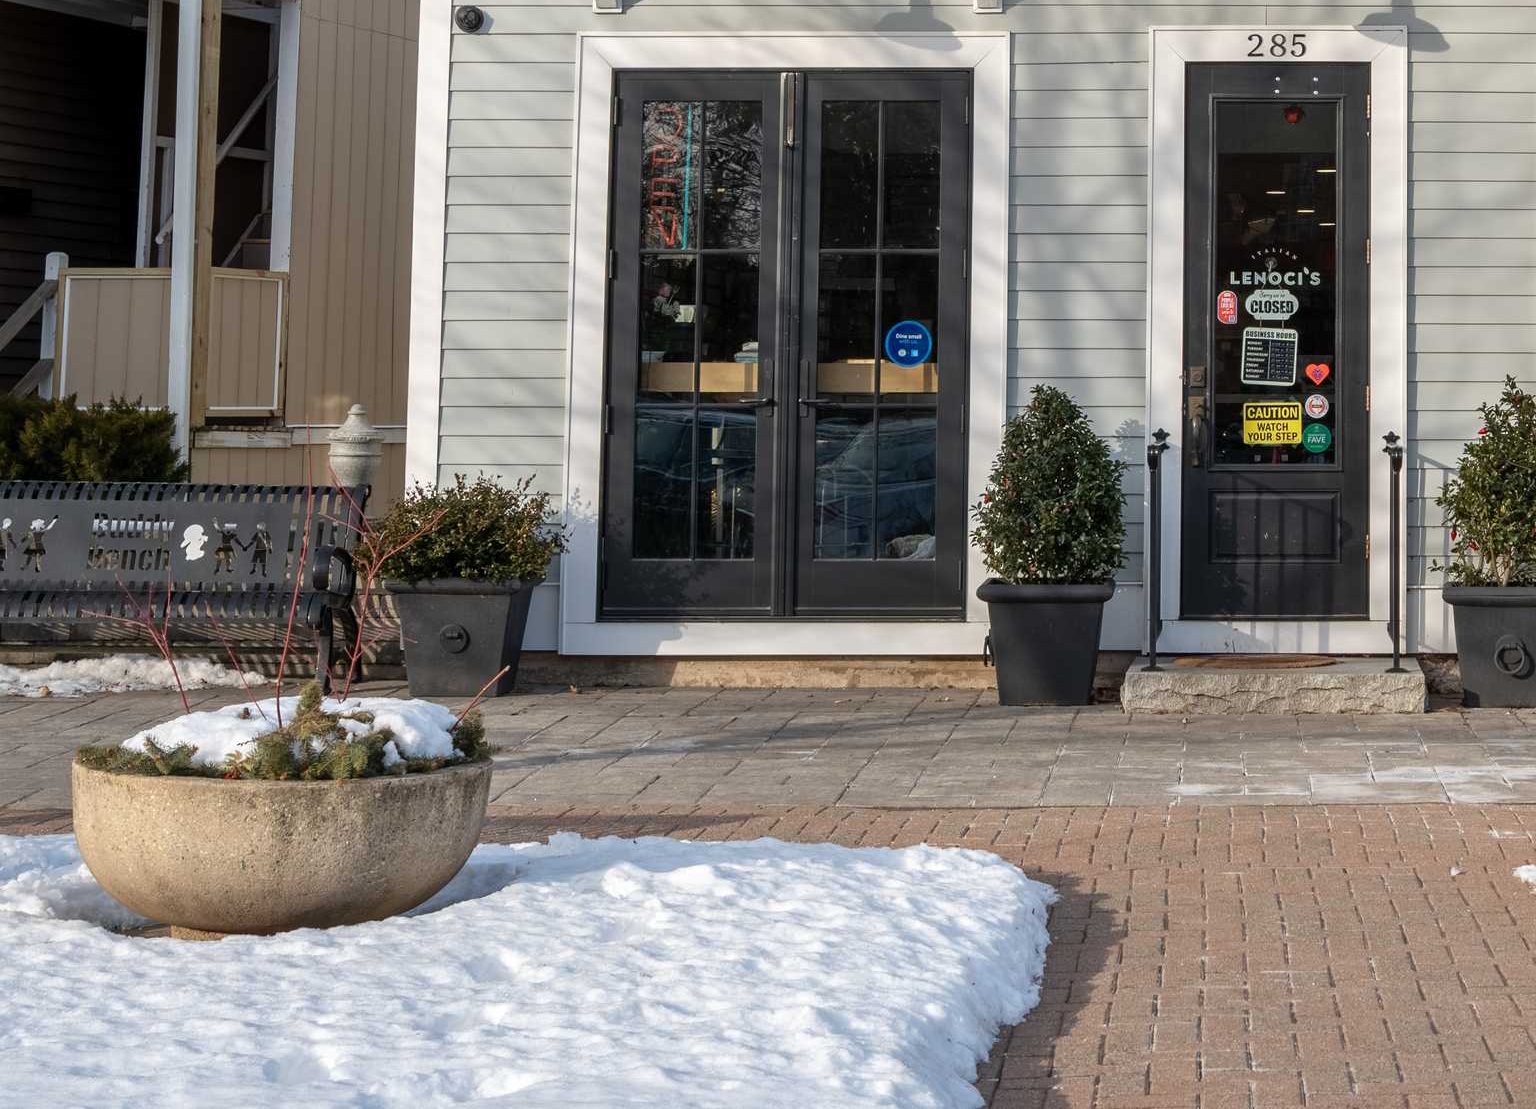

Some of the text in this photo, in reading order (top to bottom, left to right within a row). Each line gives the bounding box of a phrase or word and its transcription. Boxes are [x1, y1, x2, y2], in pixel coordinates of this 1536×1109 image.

[1247, 33, 1307, 58] 285
[1230, 267, 1321, 286] LENOCI'S
[1250, 300, 1294, 314] CLOSED
[1245, 330, 1275, 338] BUSINESS
[1247, 407, 1298, 419] CAUTION
[1257, 422, 1288, 431] WATCH
[1248, 432, 1298, 441] YOUR STEP
[92, 513, 175, 542] Buddy
